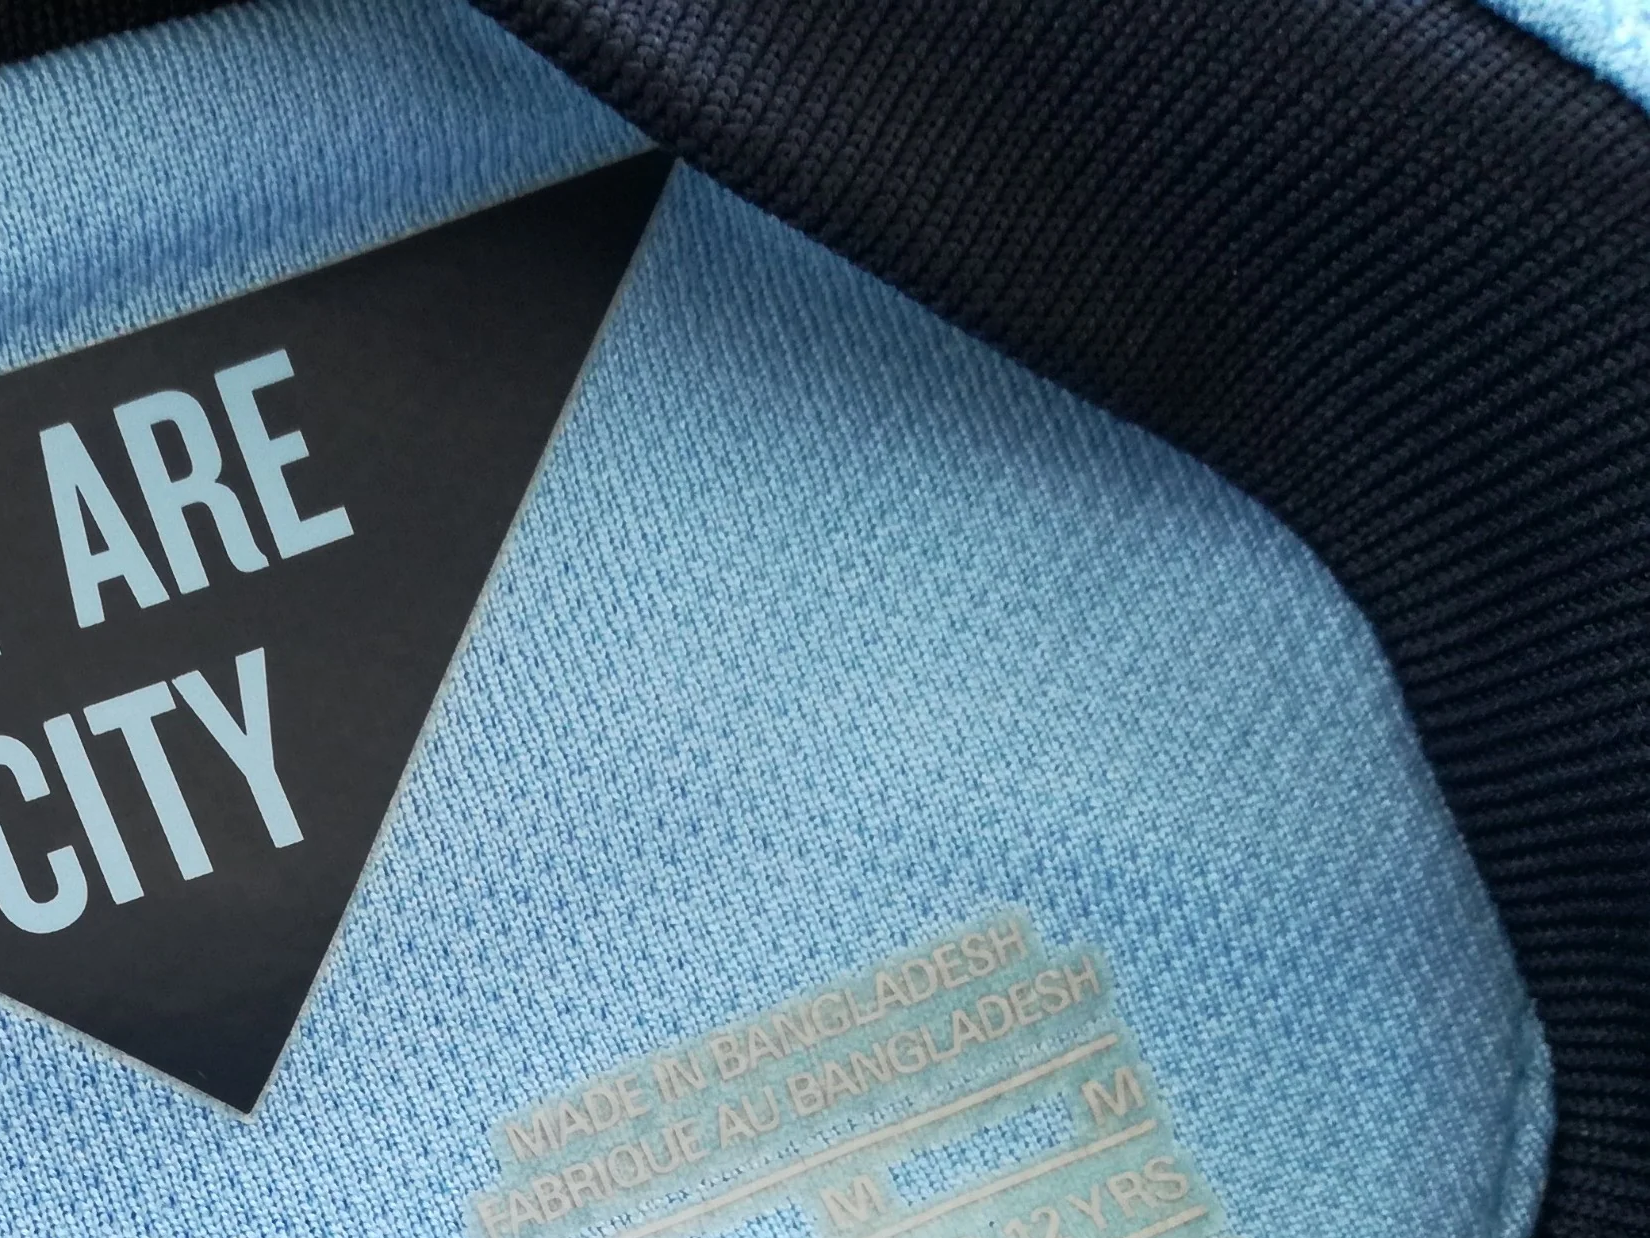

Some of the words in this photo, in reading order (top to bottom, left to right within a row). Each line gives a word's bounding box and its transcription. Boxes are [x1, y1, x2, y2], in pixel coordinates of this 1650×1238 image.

[39, 348, 355, 629] ARE
[506, 1072, 650, 1163] MADE
[653, 1052, 708, 1101] IN
[710, 920, 1029, 1081] BANGLADESH
[717, 1086, 781, 1149] AU
[785, 956, 1102, 1118] BANGLADESH
[819, 1173, 887, 1230] M
[1080, 1066, 1148, 1127] M
[1066, 1156, 1191, 1232] YRS
